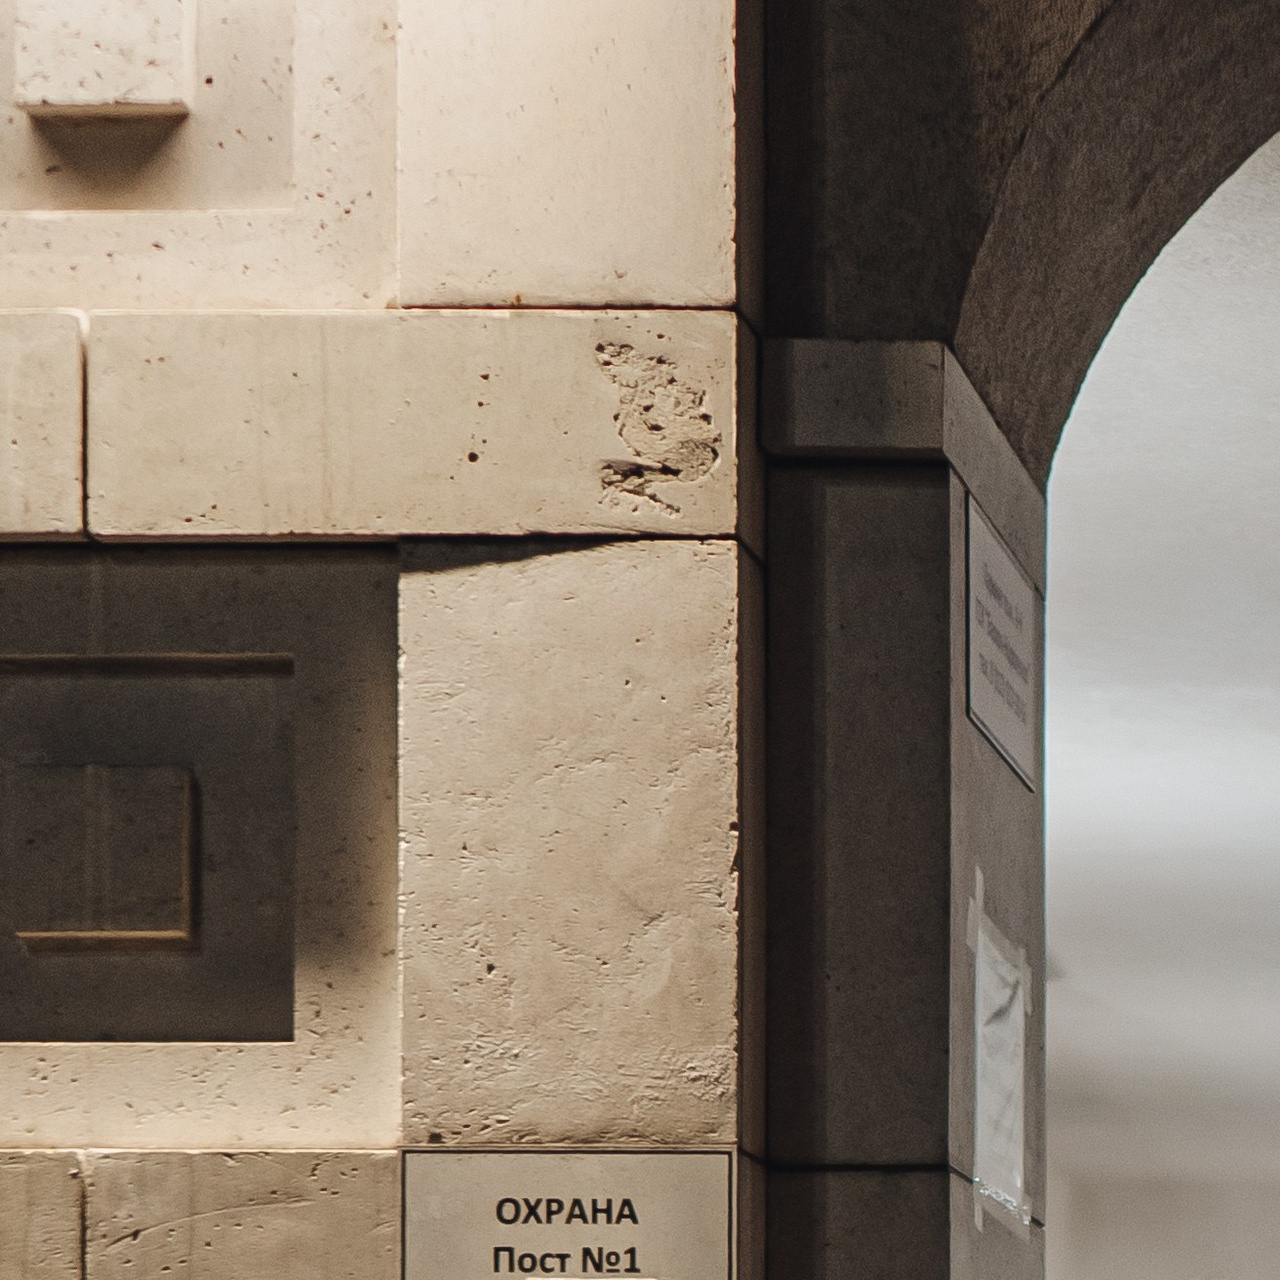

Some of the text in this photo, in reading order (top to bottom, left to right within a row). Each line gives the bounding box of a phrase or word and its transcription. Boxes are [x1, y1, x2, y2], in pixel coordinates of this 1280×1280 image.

[496, 1197, 639, 1225] ОХРАНА
[493, 1246, 641, 1274] Пост №1
